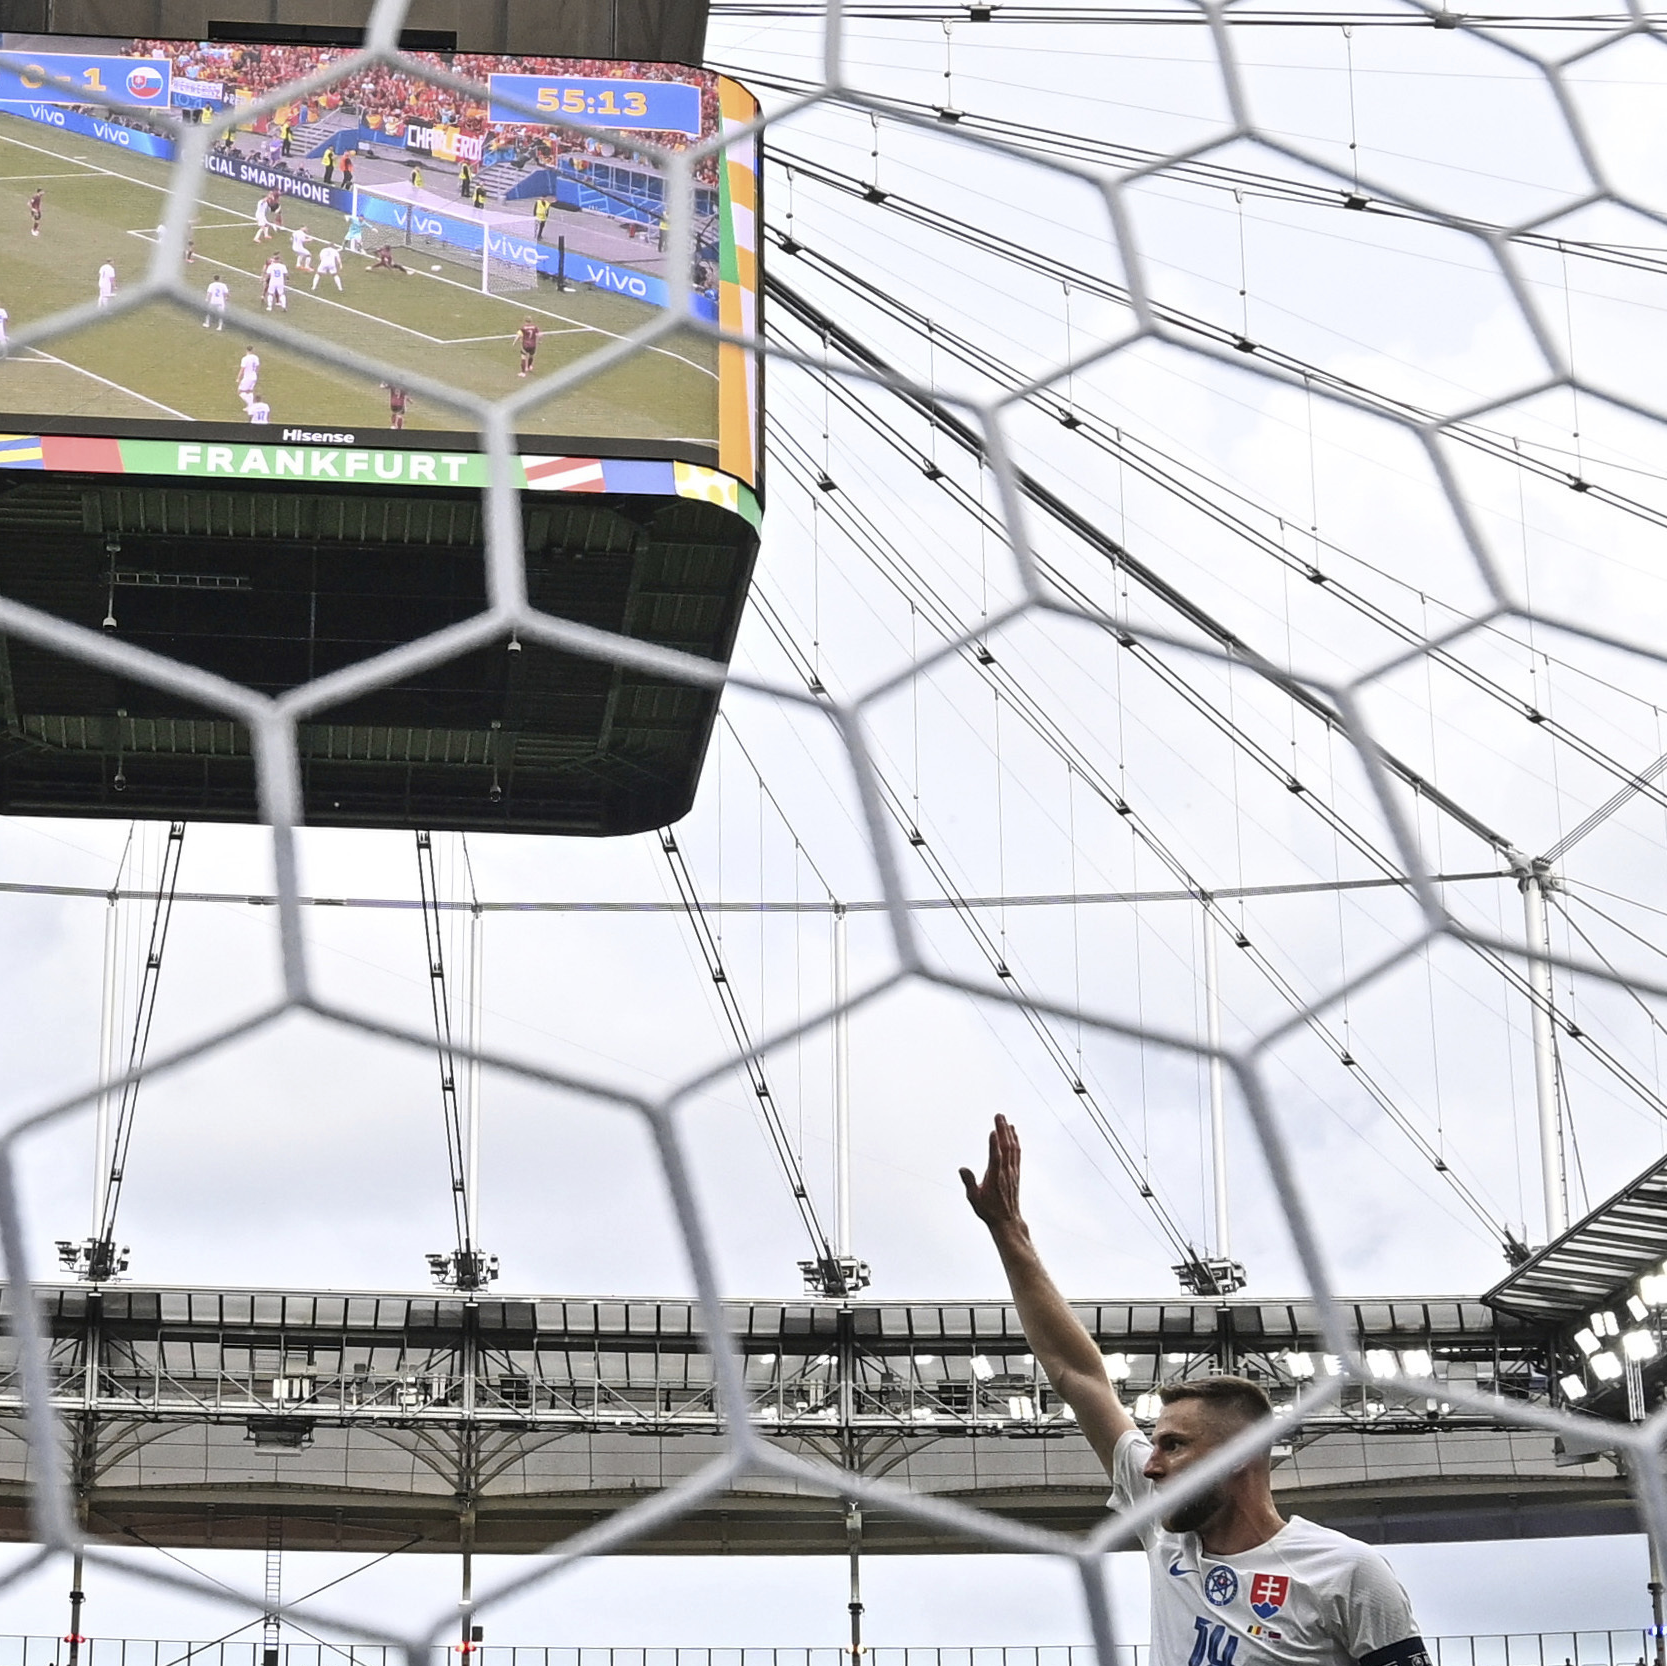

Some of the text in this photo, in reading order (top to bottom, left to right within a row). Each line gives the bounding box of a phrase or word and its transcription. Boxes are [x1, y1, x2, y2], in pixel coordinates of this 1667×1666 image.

[29, 103, 65, 126] vivo
[535, 87, 648, 117] 55:13
[92, 122, 130, 146] vivo
[240, 164, 331, 205] SMARTPHONE
[586, 264, 647, 297] vivo
[282, 429, 355, 444] Hisense
[177, 445, 468, 482] FRANKFURT
